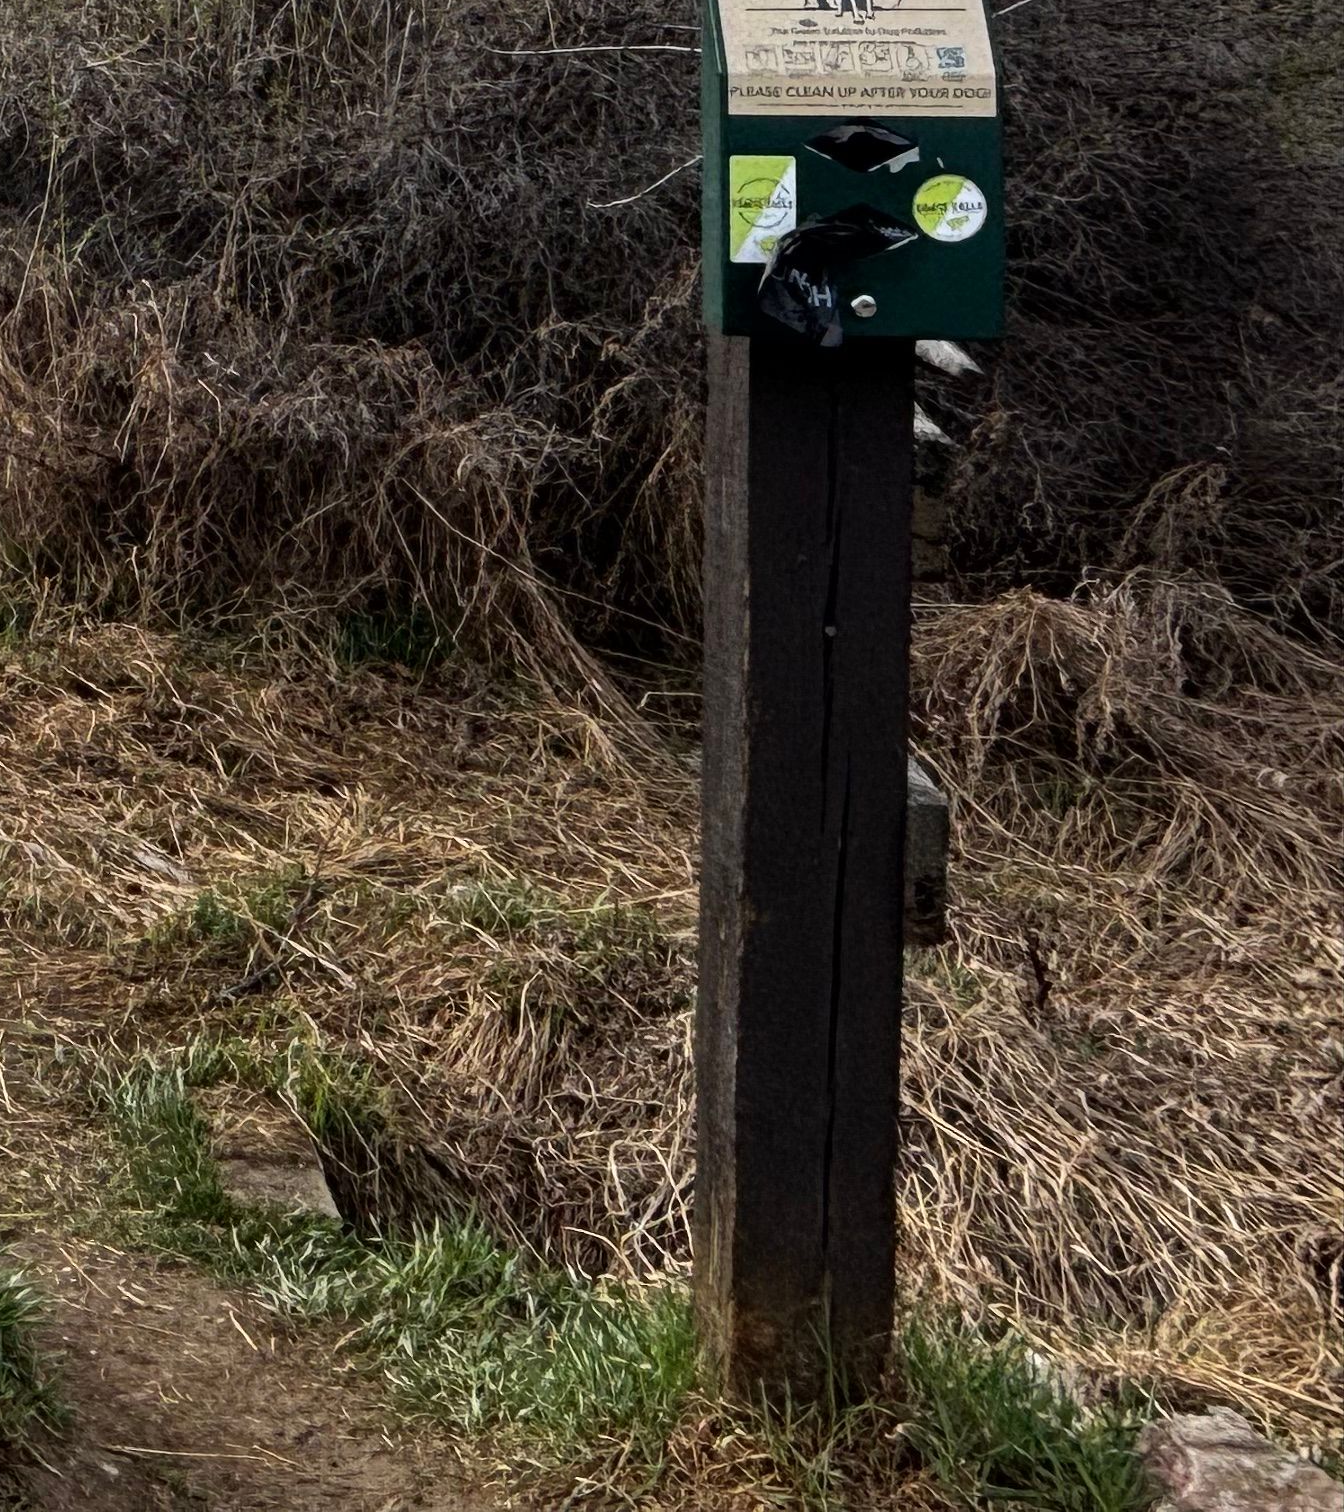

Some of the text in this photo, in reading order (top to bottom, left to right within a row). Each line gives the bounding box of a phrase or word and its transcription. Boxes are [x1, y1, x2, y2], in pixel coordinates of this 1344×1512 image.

[729, 86, 782, 99] PLEASE
[785, 86, 834, 99] CLEAN
[837, 87, 857, 99] UP
[859, 87, 906, 99] AFTER
[909, 87, 950, 99] YOUR
